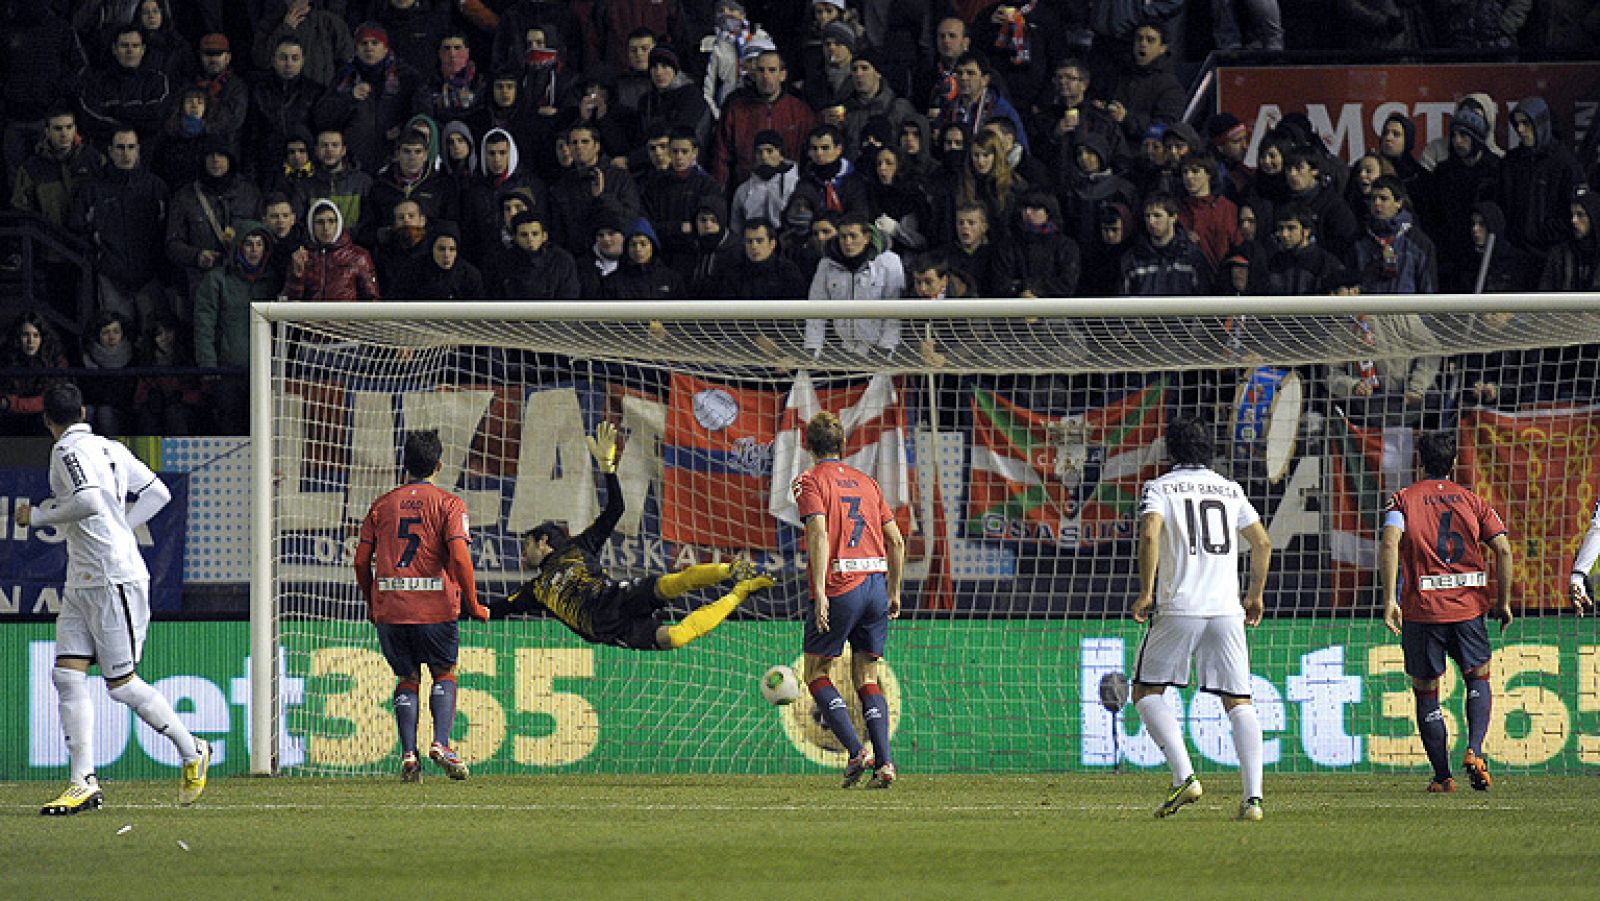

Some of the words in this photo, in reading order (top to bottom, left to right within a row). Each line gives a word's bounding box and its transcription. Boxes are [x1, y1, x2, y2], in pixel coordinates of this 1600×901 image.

[396, 517, 422, 567] 5
[840, 496, 865, 547] 3
[1183, 498, 1230, 555] 10
[1437, 511, 1465, 563] 6
[1081, 638, 1600, 766] bet36
